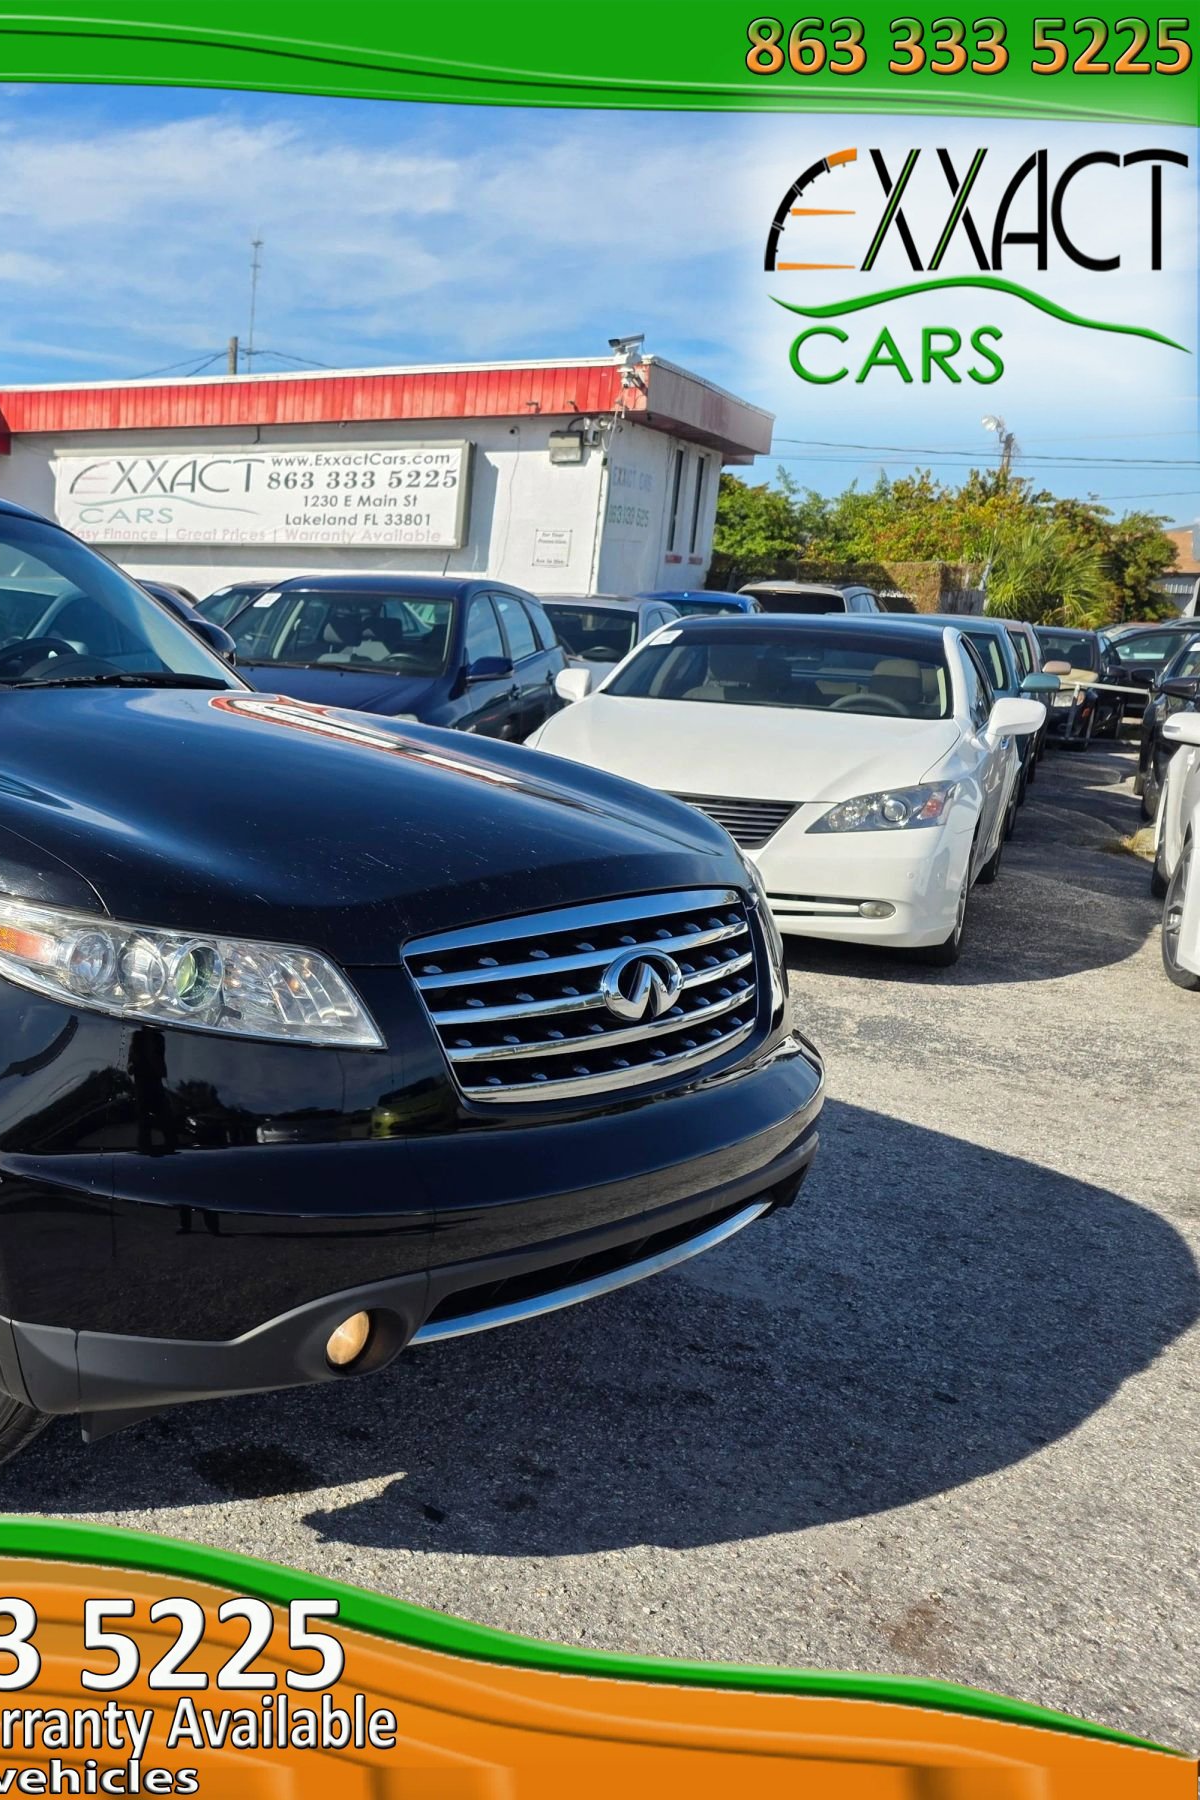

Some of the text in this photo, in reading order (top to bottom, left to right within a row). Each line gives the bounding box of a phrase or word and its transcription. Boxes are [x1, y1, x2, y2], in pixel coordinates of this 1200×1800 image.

[271, 453, 450, 467] www.ExxactCars.com
[69, 458, 265, 494] EXXACT
[267, 469, 457, 490] 863 333 5225
[304, 494, 418, 507] 1230 E Main St
[79, 508, 174, 524] CARS
[285, 514, 431, 526] Lakeland FL 33801
[73, 528, 441, 544] asy Finance Great Prices Warranty Available
